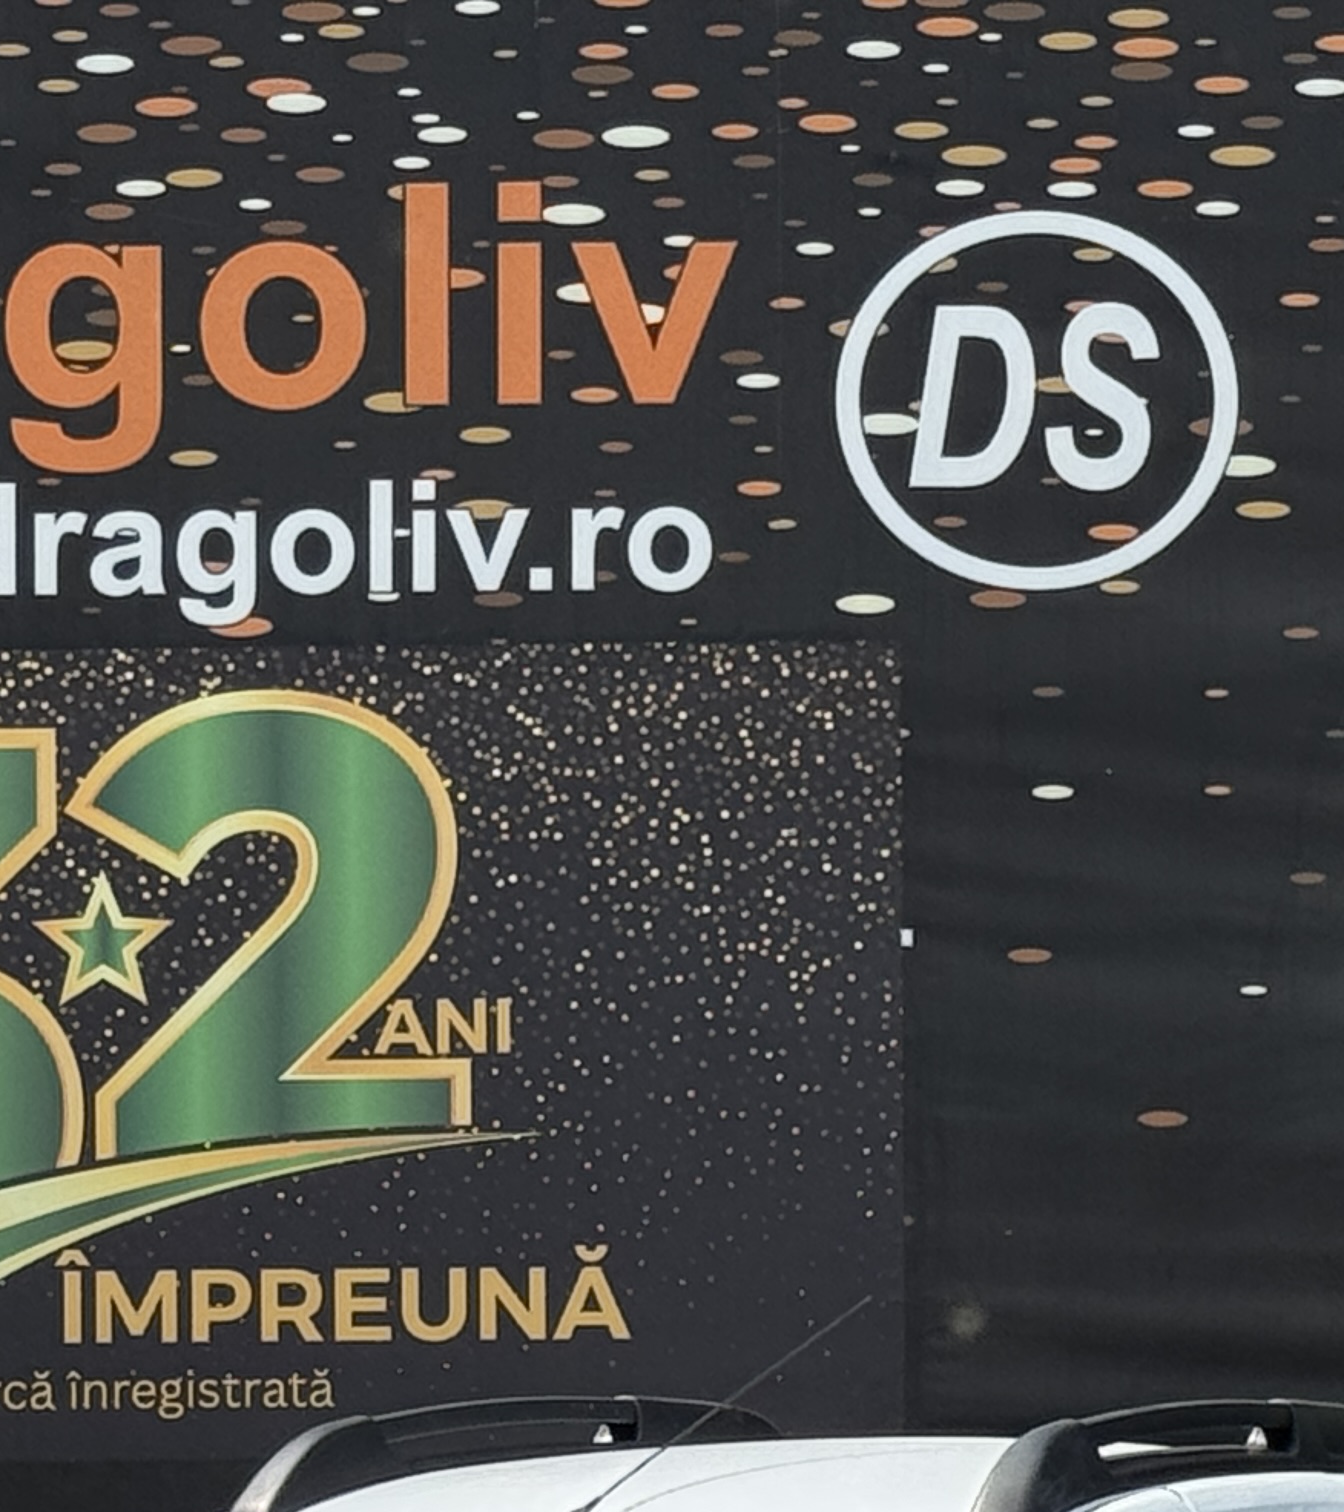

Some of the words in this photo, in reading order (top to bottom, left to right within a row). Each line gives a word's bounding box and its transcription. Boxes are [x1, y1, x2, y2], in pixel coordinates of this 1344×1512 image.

[908, 301, 1160, 492] DS
[374, 996, 514, 1055] ANI
[54, 1244, 632, 1345] ÎMPREUNĂ
[67, 1370, 336, 1420] înregistrată
